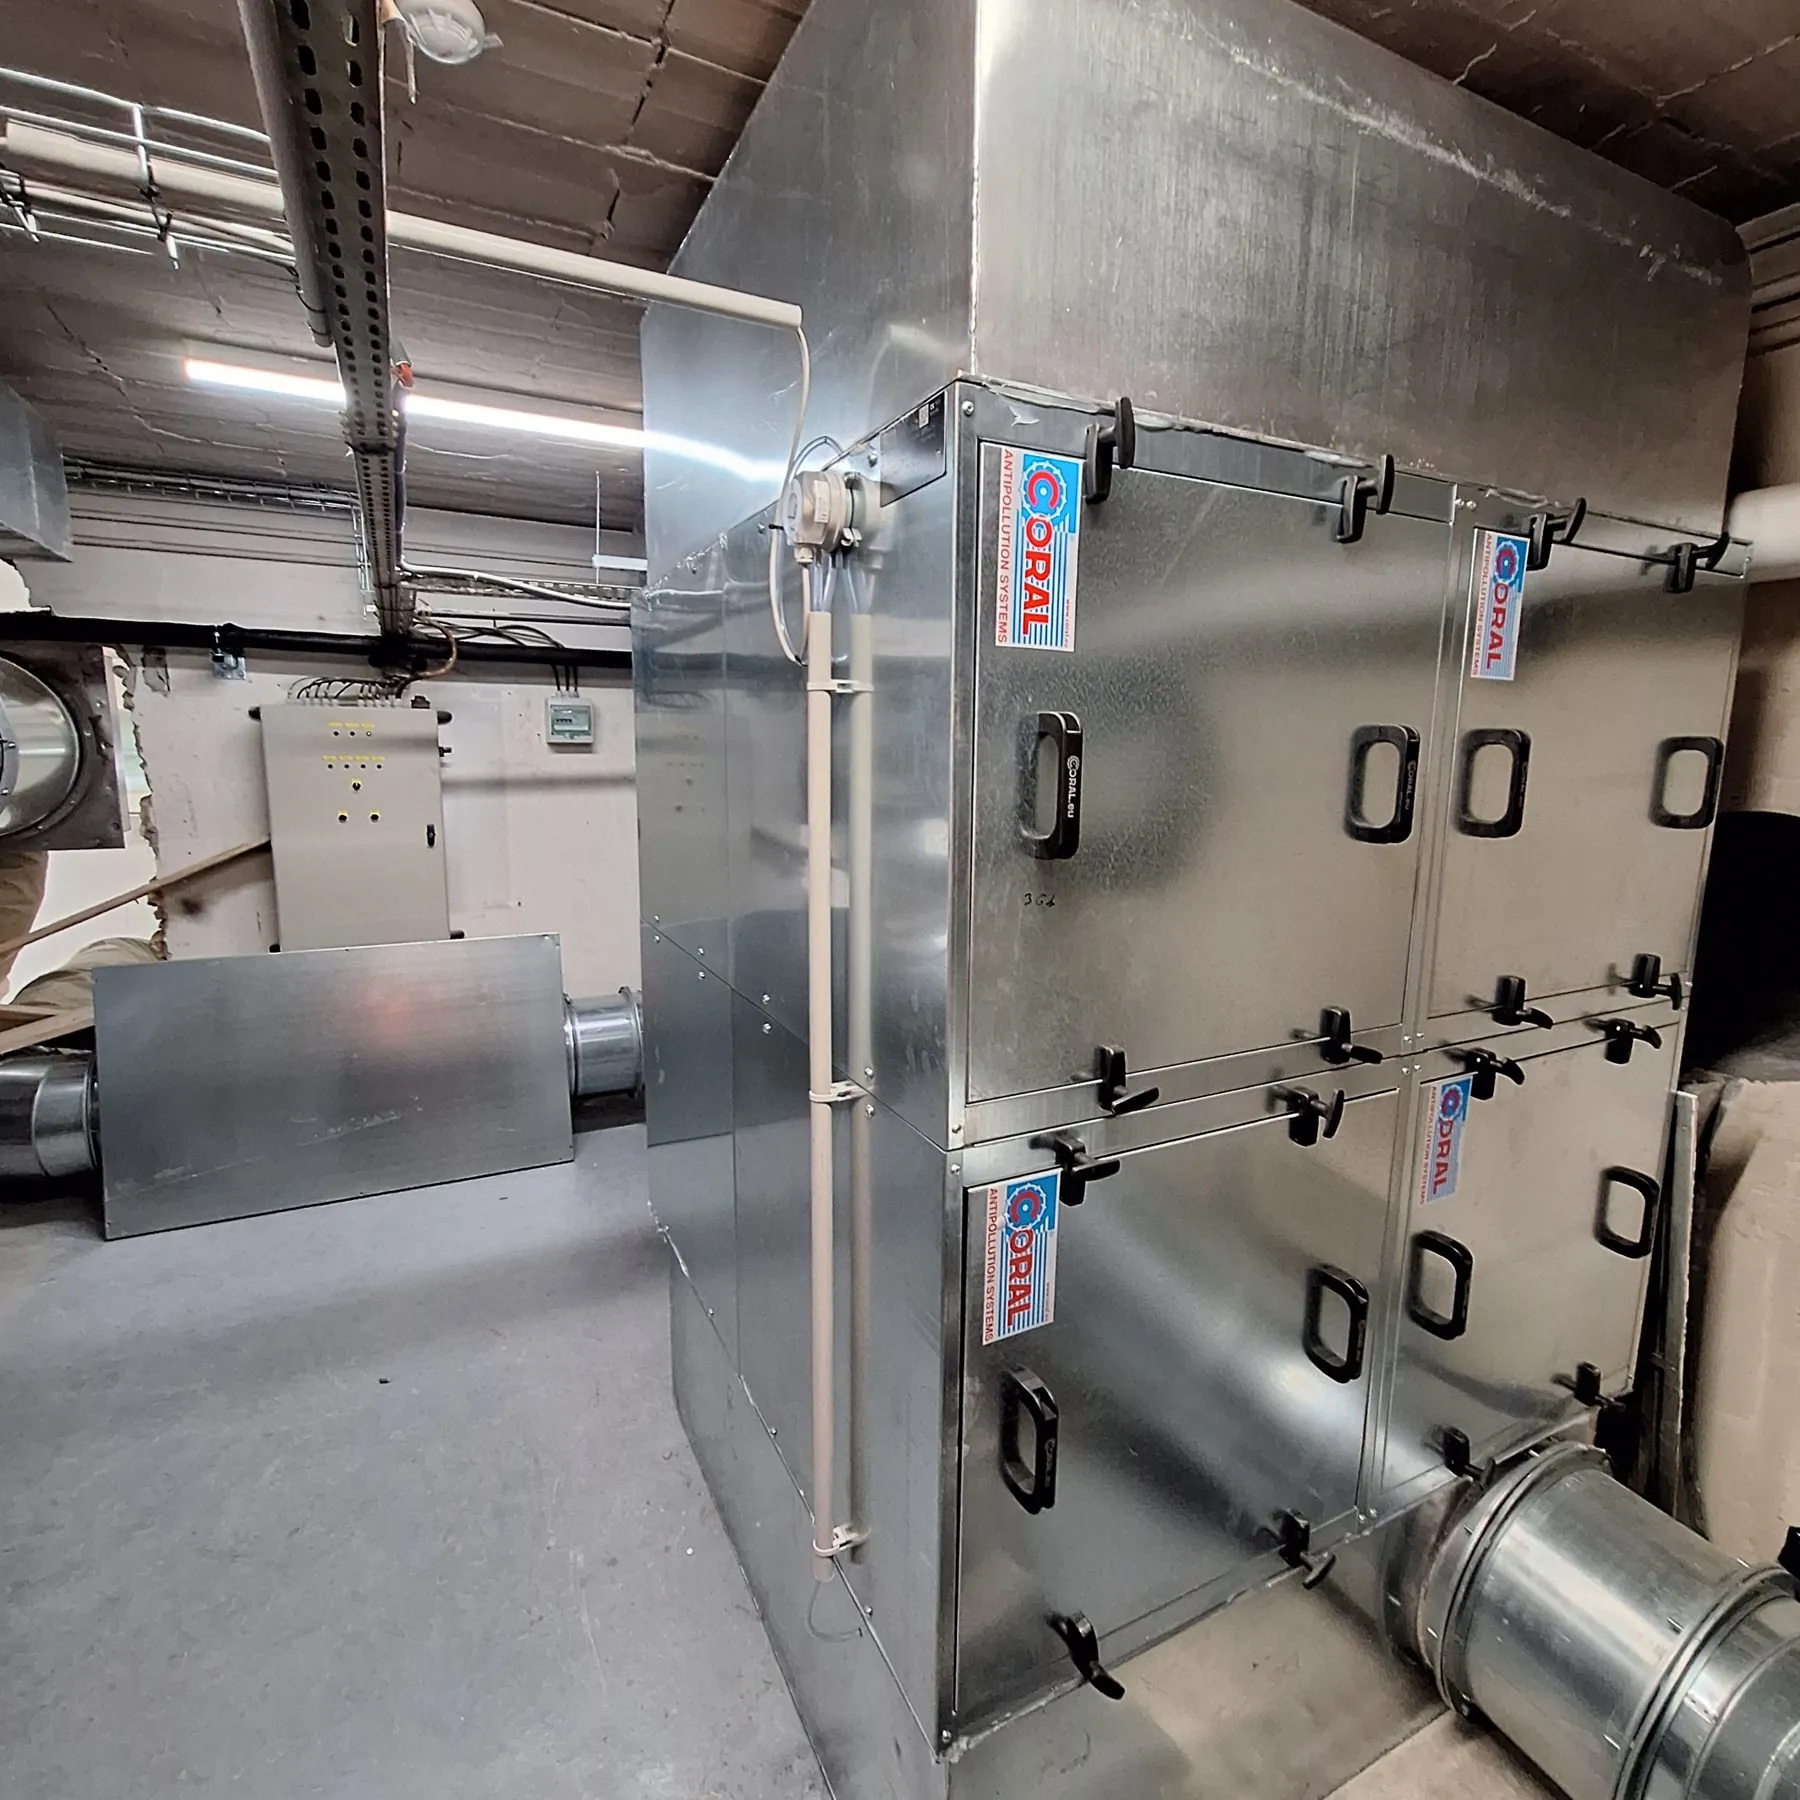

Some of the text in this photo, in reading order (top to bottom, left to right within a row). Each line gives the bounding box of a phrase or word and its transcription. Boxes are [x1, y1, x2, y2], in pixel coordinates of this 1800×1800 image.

[998, 449, 1013, 643] ANTIPOLLUTION SYSTEMS
[1021, 469, 1062, 635] CORAL
[1473, 533, 1492, 676] ANTIPOLLUTION SYSTEMS
[1487, 547, 1518, 671] CORAL
[1067, 755, 1080, 818] CORAL.eu
[1433, 1087, 1463, 1194] CORAL
[984, 1188, 998, 1341] ANTIPOLLUTION SYSTEMS
[1007, 1188, 1043, 1326] CORAL
